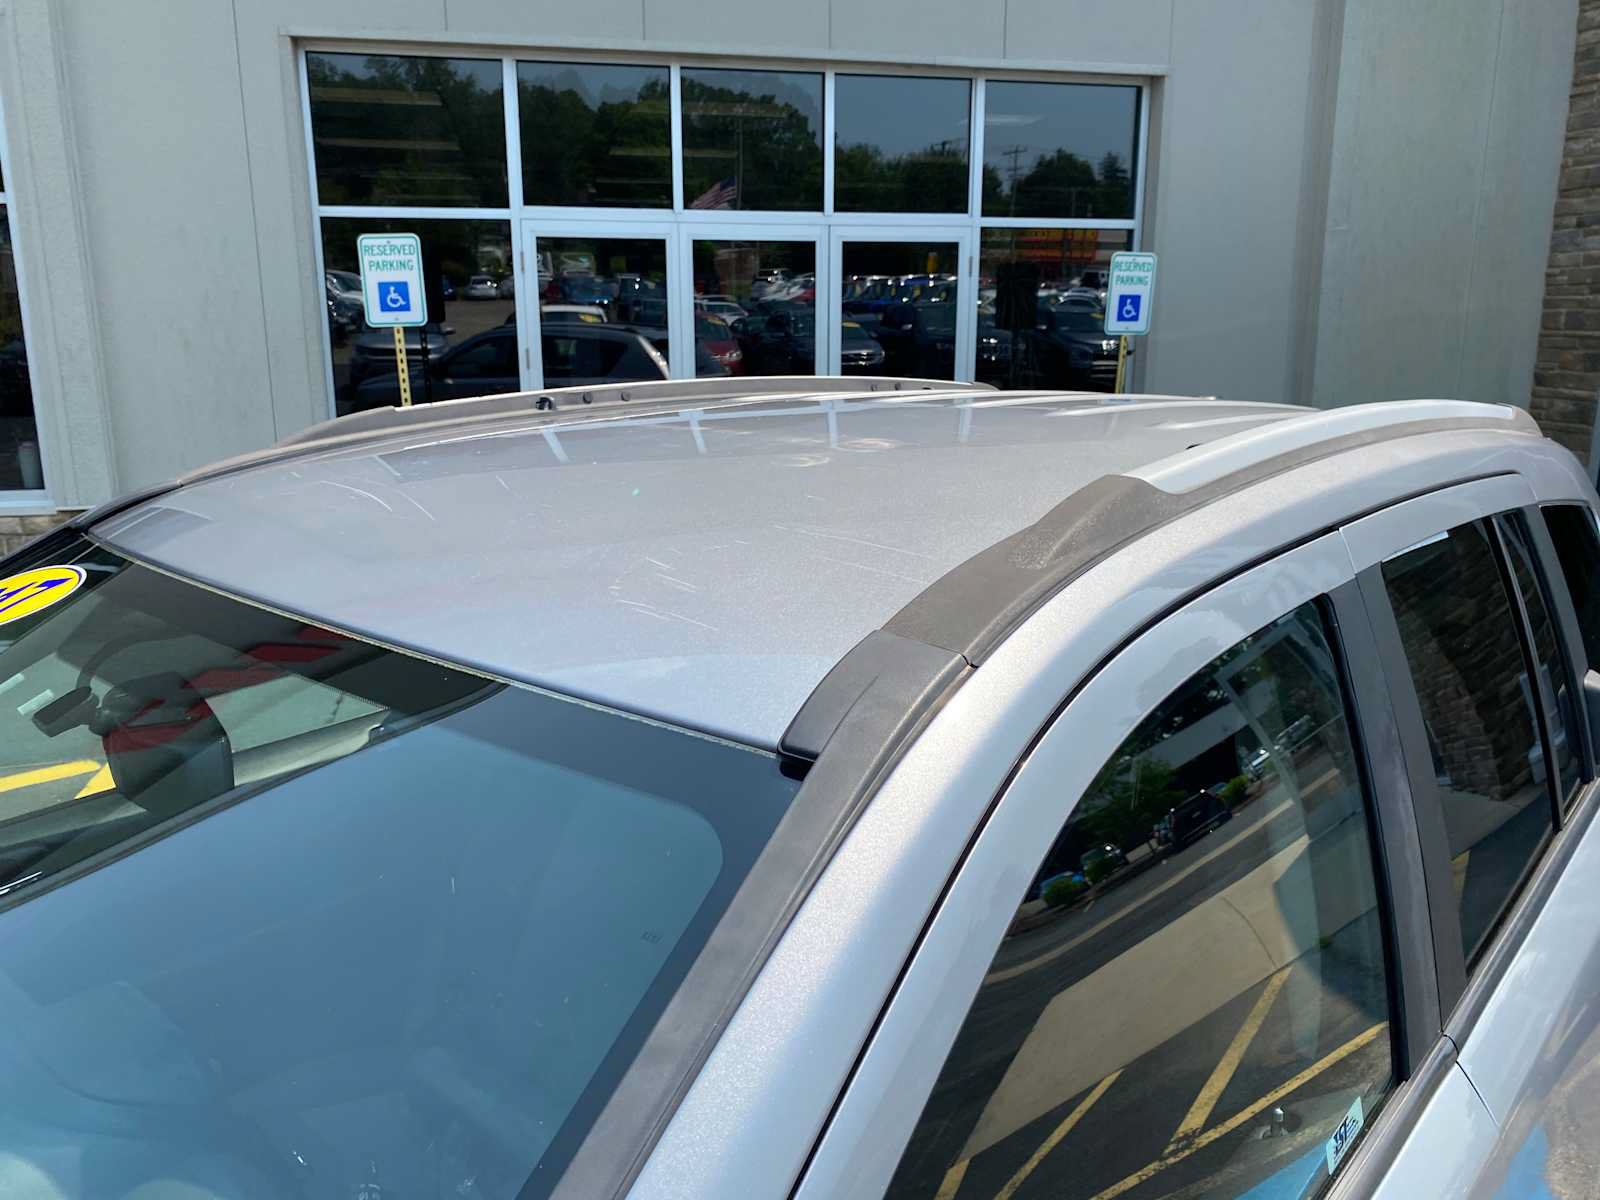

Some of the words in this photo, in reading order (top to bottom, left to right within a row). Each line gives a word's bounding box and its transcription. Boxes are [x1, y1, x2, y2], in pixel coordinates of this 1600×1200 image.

[363, 245, 415, 256] RESERVED
[369, 259, 413, 271] PARKING
[1112, 261, 1152, 272] RESERVED
[1115, 274, 1149, 285] PARKING
